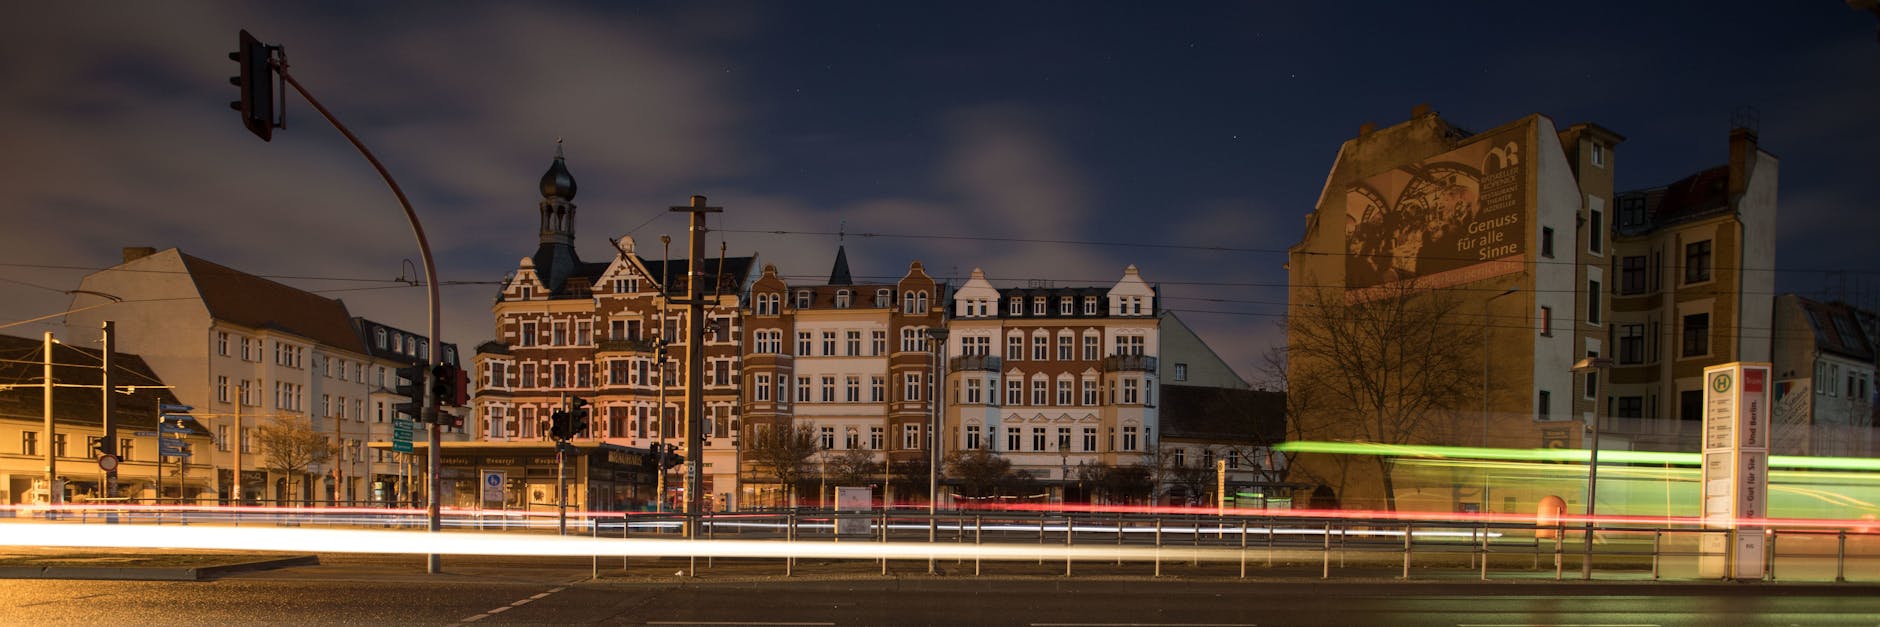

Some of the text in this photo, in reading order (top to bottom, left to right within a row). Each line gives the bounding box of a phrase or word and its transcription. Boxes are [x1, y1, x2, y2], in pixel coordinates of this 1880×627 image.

[1468, 213, 1518, 234] Genuss
[1457, 230, 1504, 252] für alle
[1479, 243, 1517, 261] Sinne
[1747, 456, 1755, 470] Sie.
[1747, 472, 1755, 485] für
[1747, 487, 1755, 502] Gut
